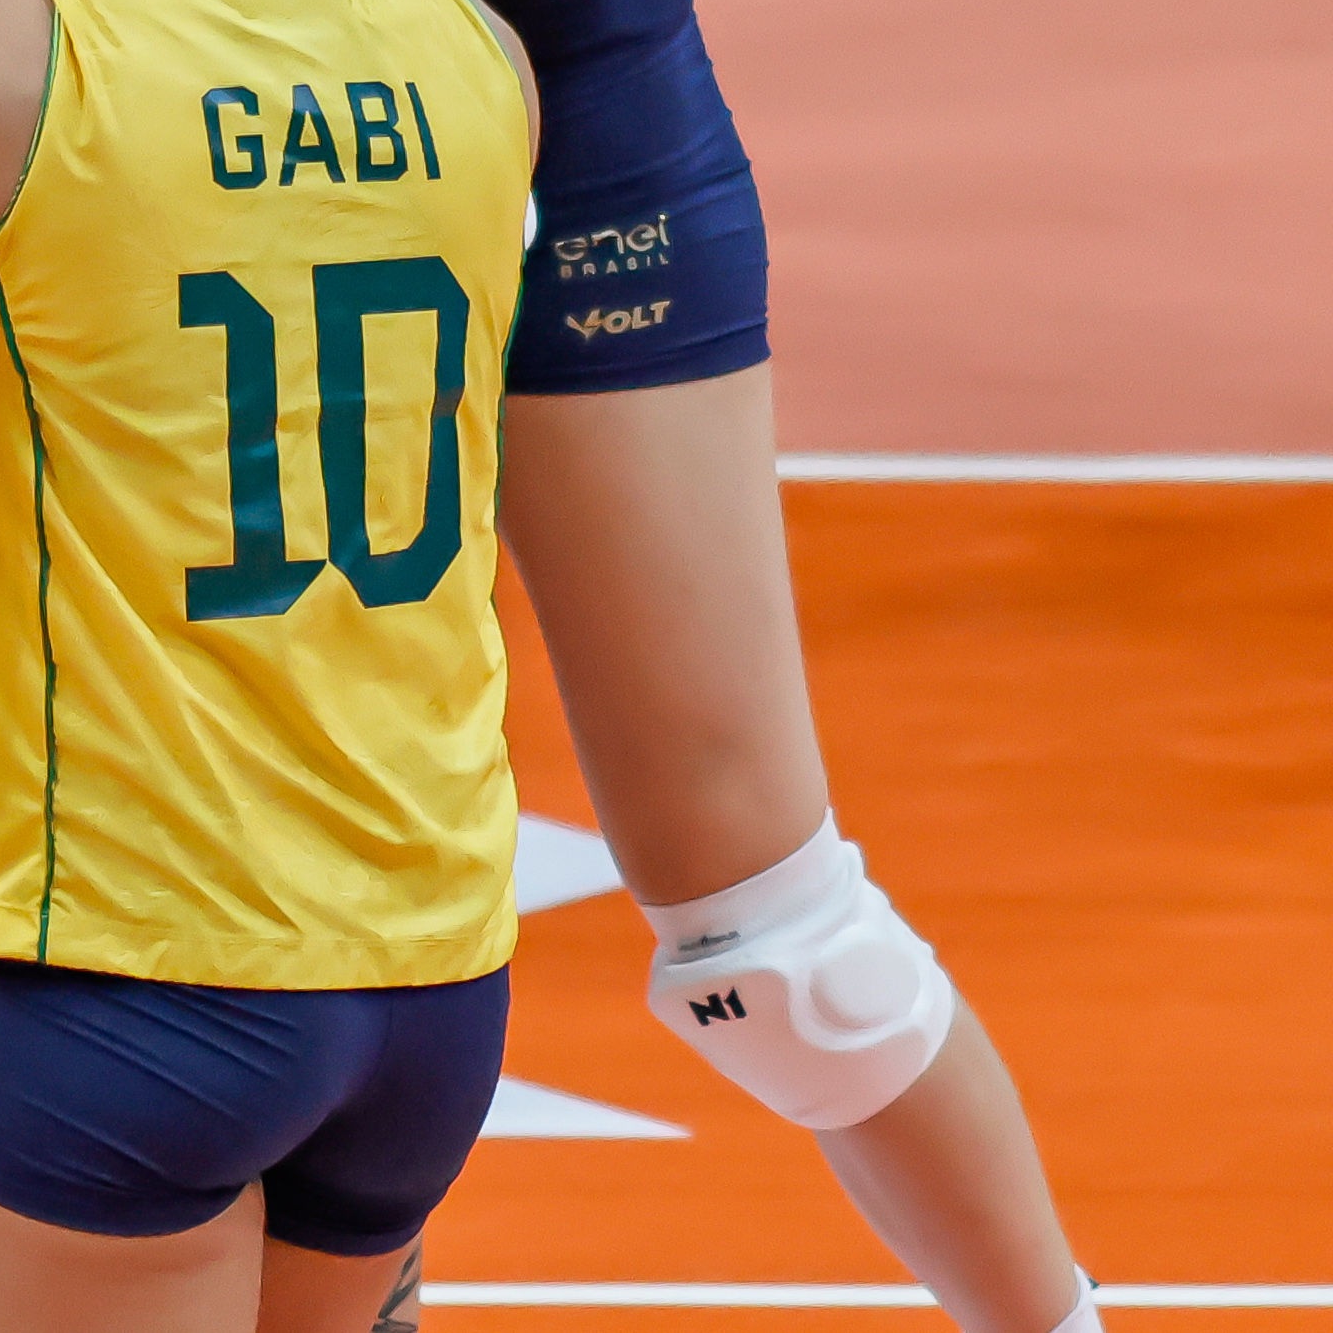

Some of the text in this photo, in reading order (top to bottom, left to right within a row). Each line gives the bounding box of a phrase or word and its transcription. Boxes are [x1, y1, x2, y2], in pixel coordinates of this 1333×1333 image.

[201, 81, 441, 190] GABI
[565, 300, 671, 340] VOLT
[178, 255, 470, 623] 10
[689, 986, 747, 1027] N1
